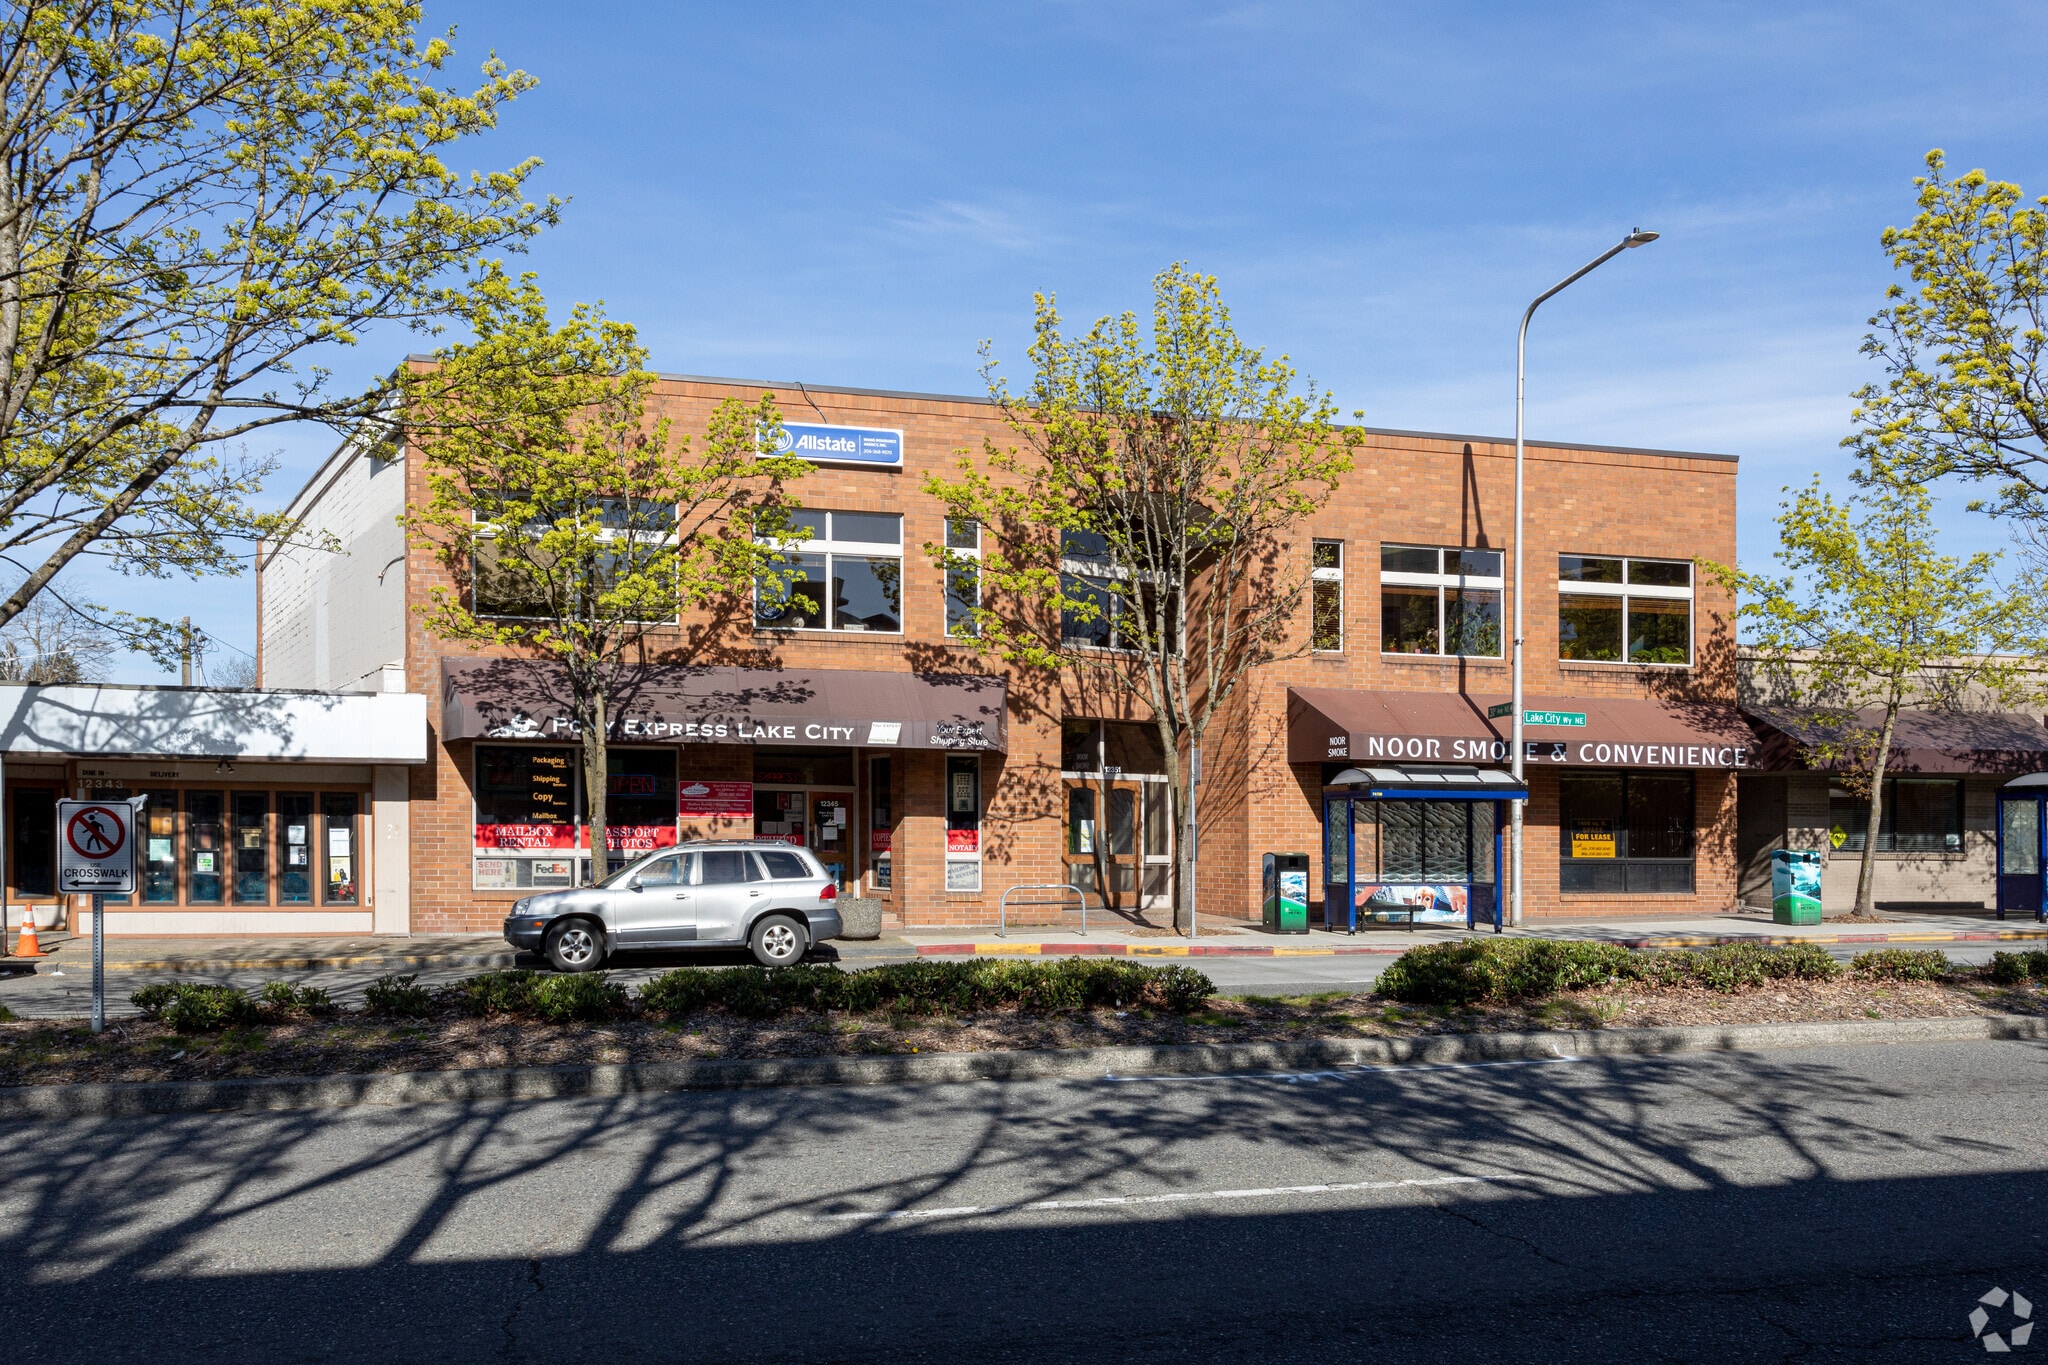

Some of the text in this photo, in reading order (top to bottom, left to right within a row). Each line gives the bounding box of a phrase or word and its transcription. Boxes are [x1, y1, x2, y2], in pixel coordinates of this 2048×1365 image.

[795, 435, 856, 452] Allstate
[1526, 713, 1543, 722] Lake
[1545, 713, 1560, 725] City
[1563, 717, 1571, 725] Wy
[936, 725, 982, 735] Your Expert
[930, 735, 988, 747] Shipping Store
[1330, 736, 1346, 745] NOOR
[1328, 748, 1347, 757] SMOKE
[1369, 737, 1440, 758] NOOR
[1551, 743, 1567, 762] &
[1579, 743, 1746, 766] CONVENIENCE
[78, 779, 123, 788] 12343
[532, 775, 560, 783] Shipping
[532, 792, 553, 802] Copy
[496, 827, 554, 836] MAILBOX
[605, 828, 659, 838] ASSPORT
[500, 837, 551, 847] RENTAL
[606, 839, 653, 848] PHOTOS
[536, 864, 567, 873] FedEx
[64, 869, 128, 878] CROSSWALK
